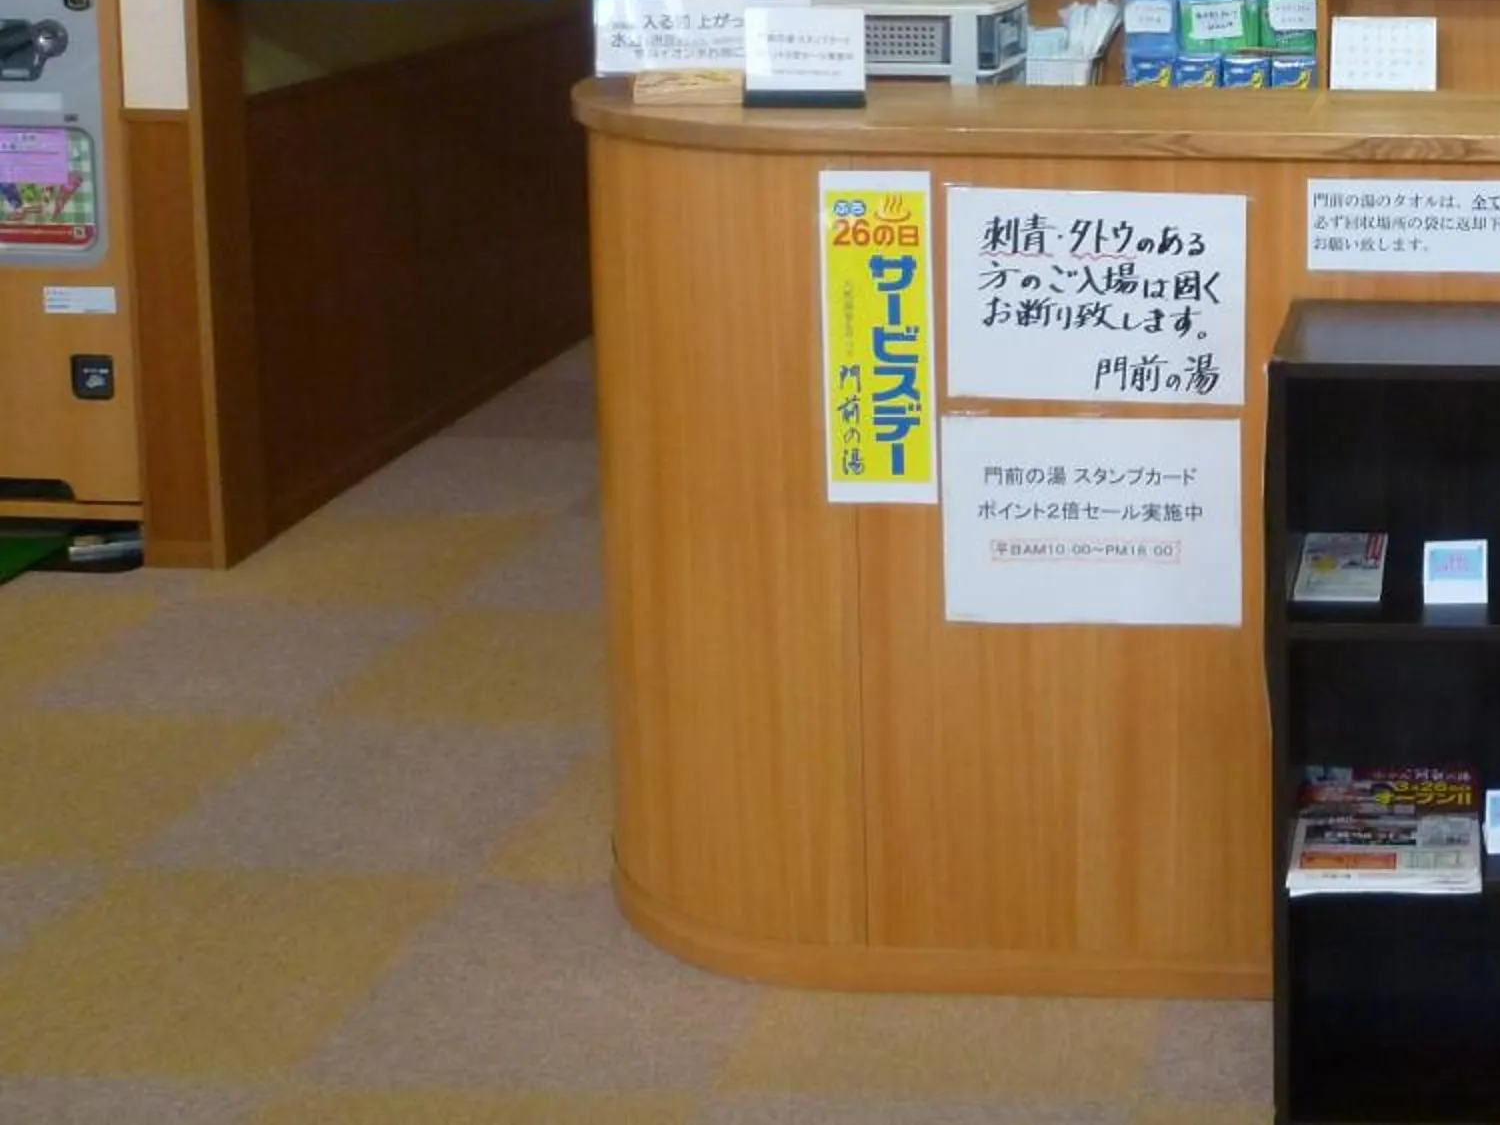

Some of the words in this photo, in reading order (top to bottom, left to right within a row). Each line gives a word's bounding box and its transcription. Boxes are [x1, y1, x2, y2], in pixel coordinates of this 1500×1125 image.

[832, 219, 919, 247] 26の日
[978, 260, 1220, 305] 方のご入場は固く
[982, 297, 1208, 341] お断り致します。
[868, 254, 921, 476] サービスデー
[1094, 352, 1221, 395] 門前の湯
[836, 364, 865, 475] 門前の湯
[984, 467, 1066, 485] 門前の湯
[1074, 467, 1196, 486] スタンプカード
